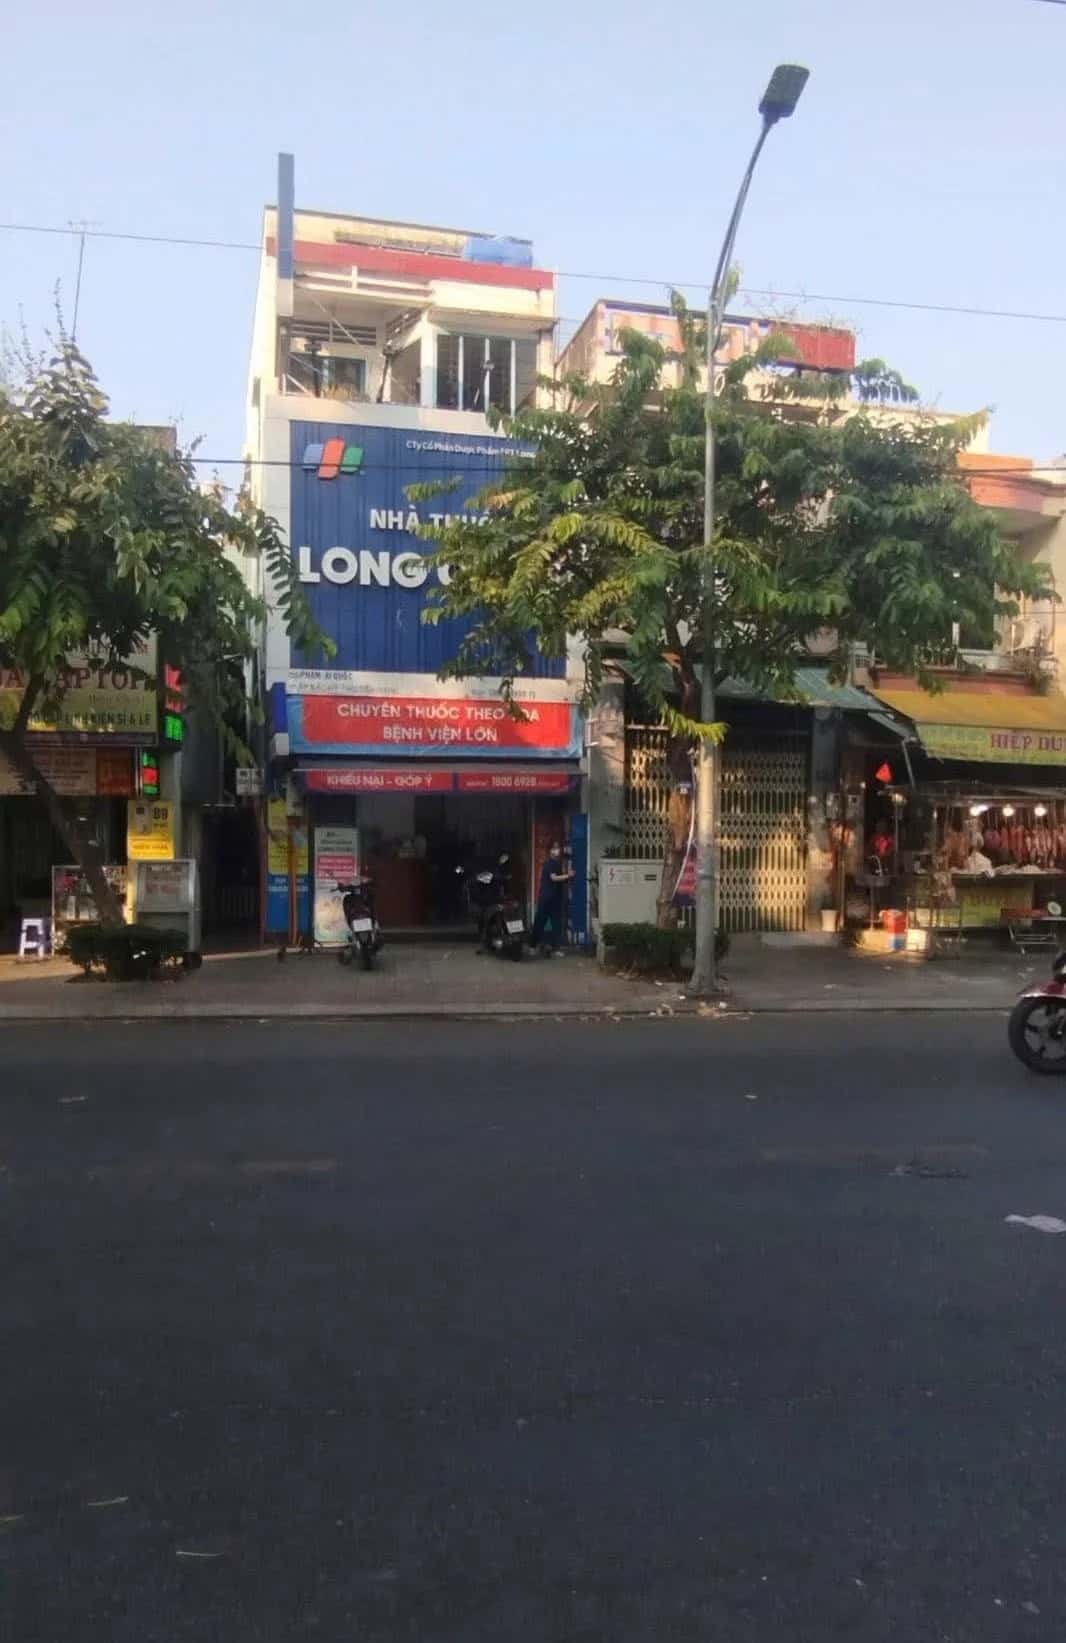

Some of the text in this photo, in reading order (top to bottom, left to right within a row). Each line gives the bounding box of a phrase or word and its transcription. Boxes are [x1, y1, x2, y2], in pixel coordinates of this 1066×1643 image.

[369, 504, 506, 531] NHÀ THUỐ
[299, 546, 428, 588] LONG
[0, 666, 25, 689] A
[407, 701, 460, 719] THUỐC
[466, 706, 506, 721] THEO
[427, 721, 462, 745] VIỆN
[1039, 736, 1066, 751] DU
